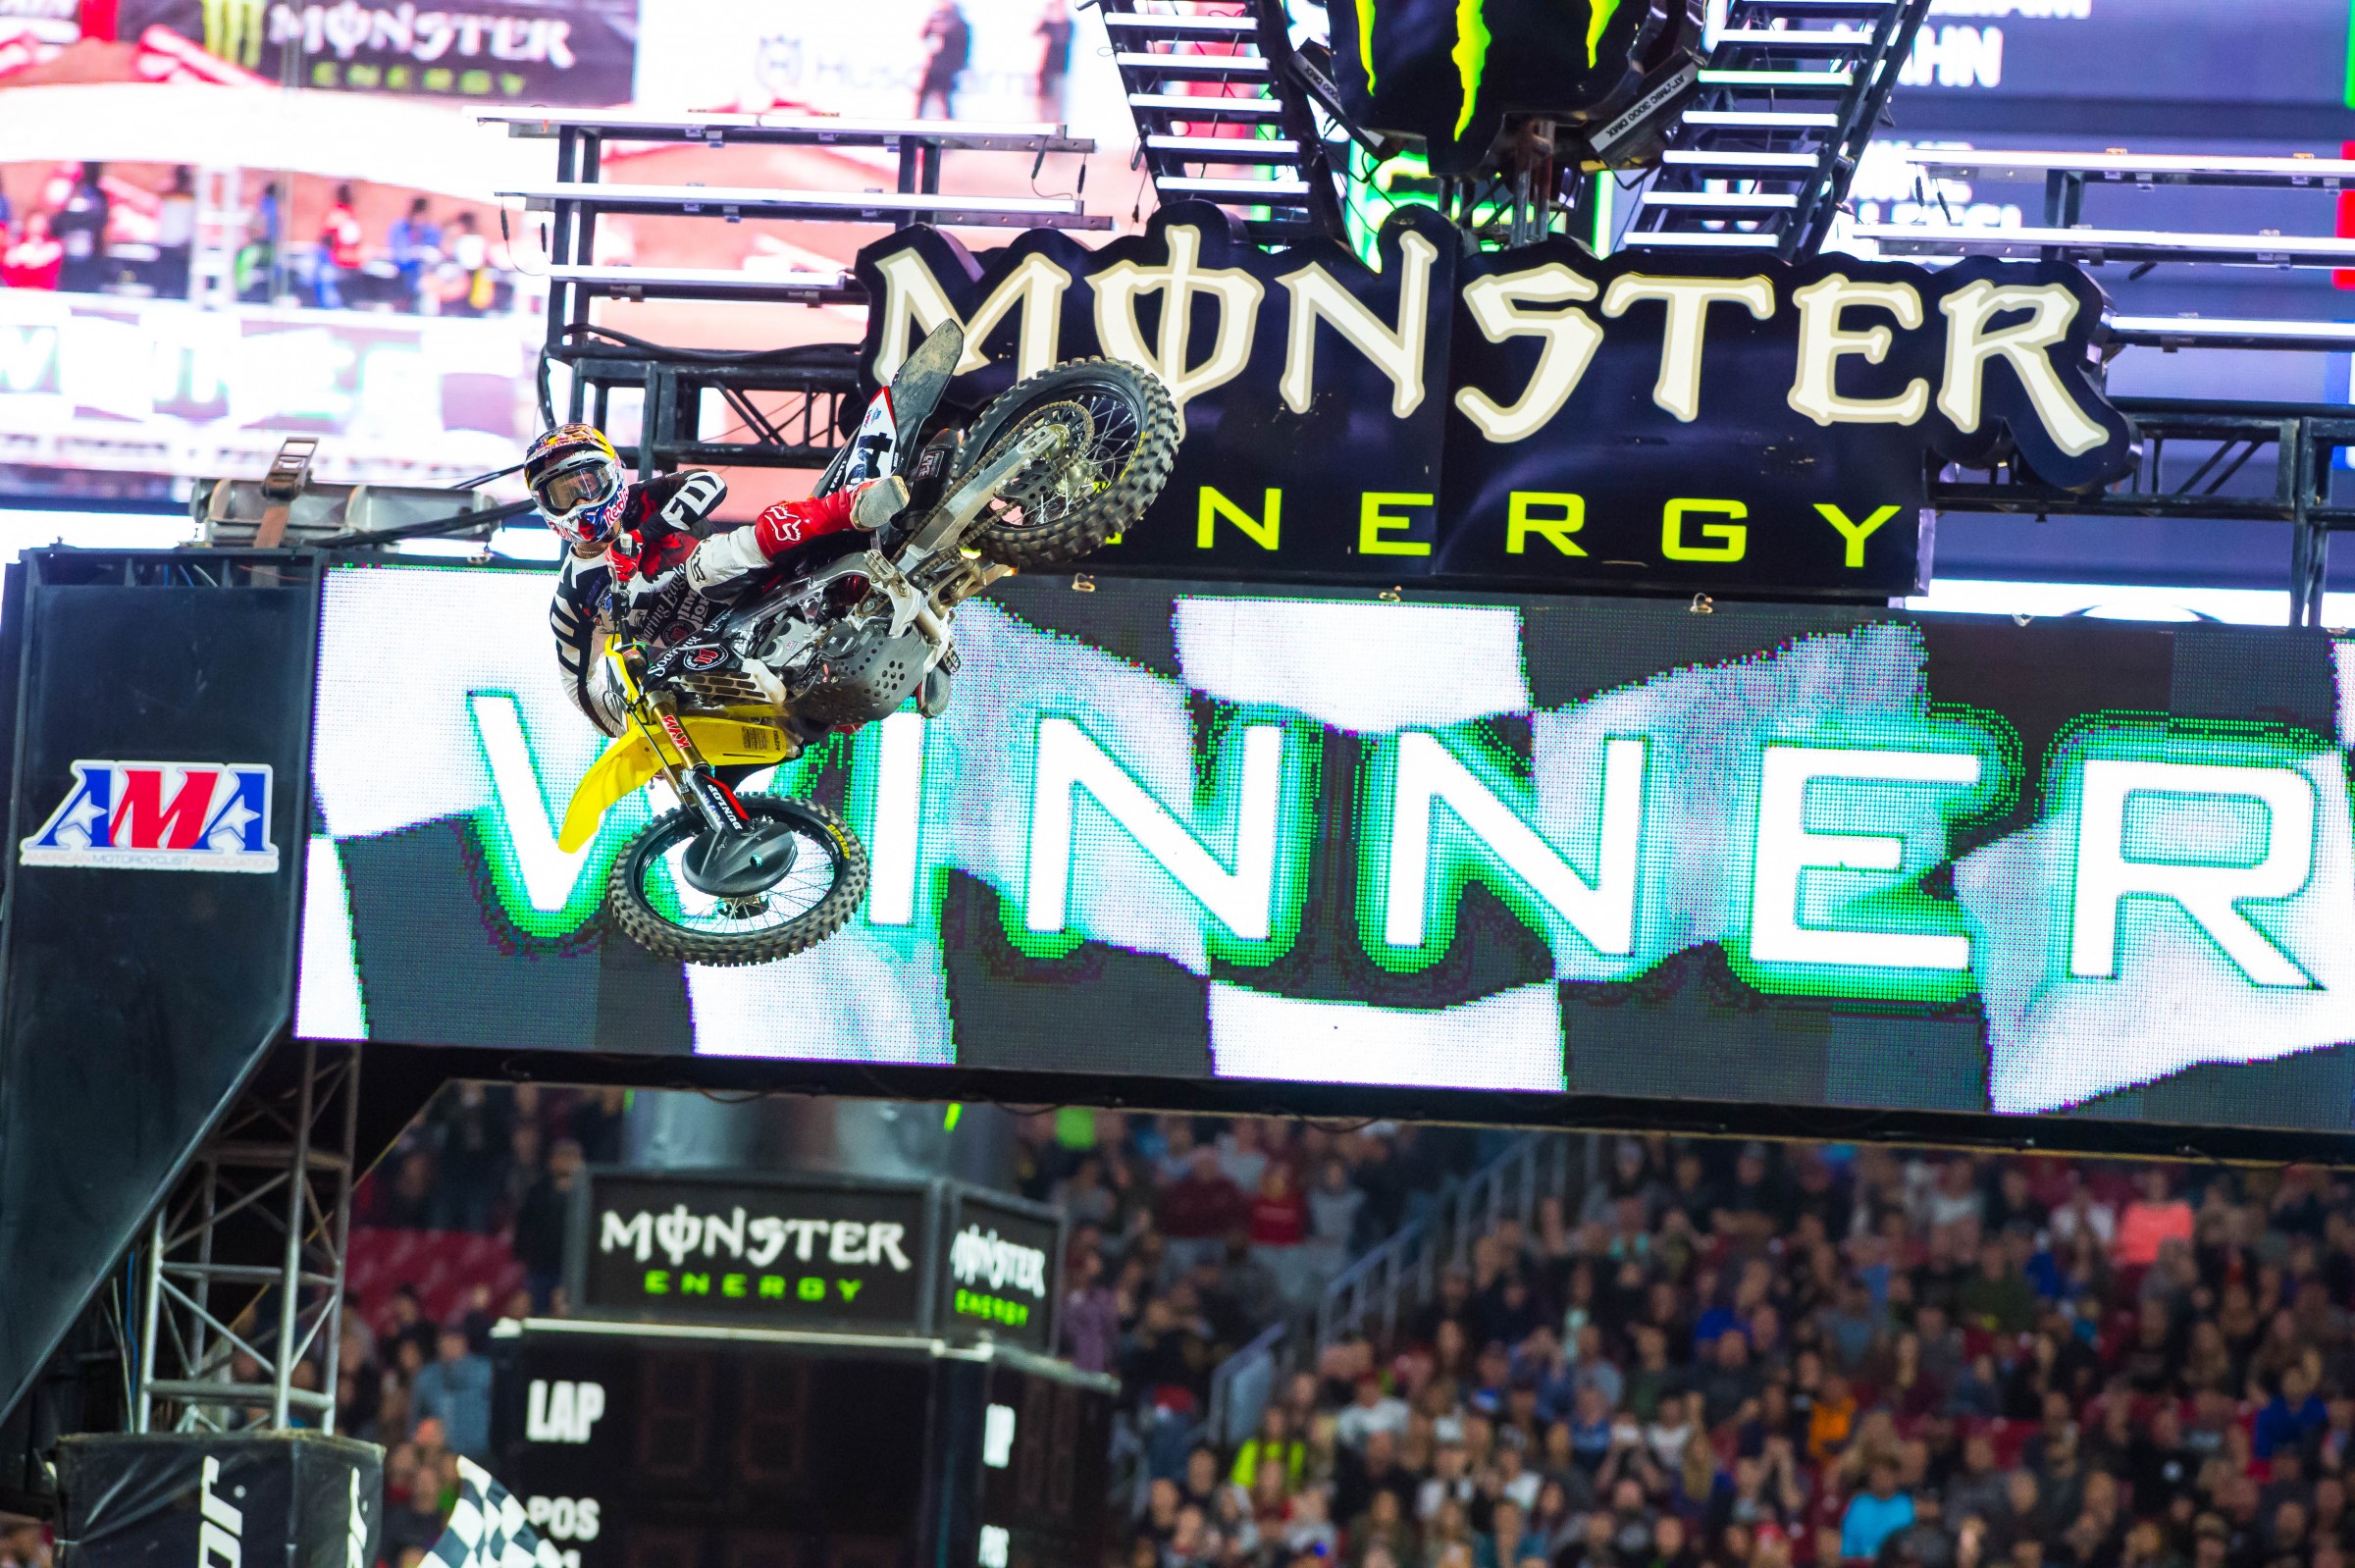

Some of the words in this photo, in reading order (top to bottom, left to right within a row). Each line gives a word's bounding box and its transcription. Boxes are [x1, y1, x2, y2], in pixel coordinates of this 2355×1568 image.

[268, 0, 576, 69] MONSTER
[1605, 117, 1629, 138] DMX
[873, 224, 2110, 457] MONSTER
[1106, 484, 1903, 568] NERGY
[659, 562, 687, 609] Eagle
[677, 589, 699, 620] JIM
[662, 714, 692, 751] KYB
[24, 761, 277, 855] AMA
[706, 783, 743, 832] DUNLOP
[25, 852, 91, 863] AMERICAN
[92, 853, 190, 866] MOTORCYCLIST
[190, 855, 276, 868] ASSOCIATION
[826, 822, 852, 860] DUNLOP
[600, 1204, 913, 1272] MONSTER
[644, 1270, 864, 1304] ENERGY
[526, 1379, 605, 1444] LAP
[527, 1494, 602, 1542] POS
